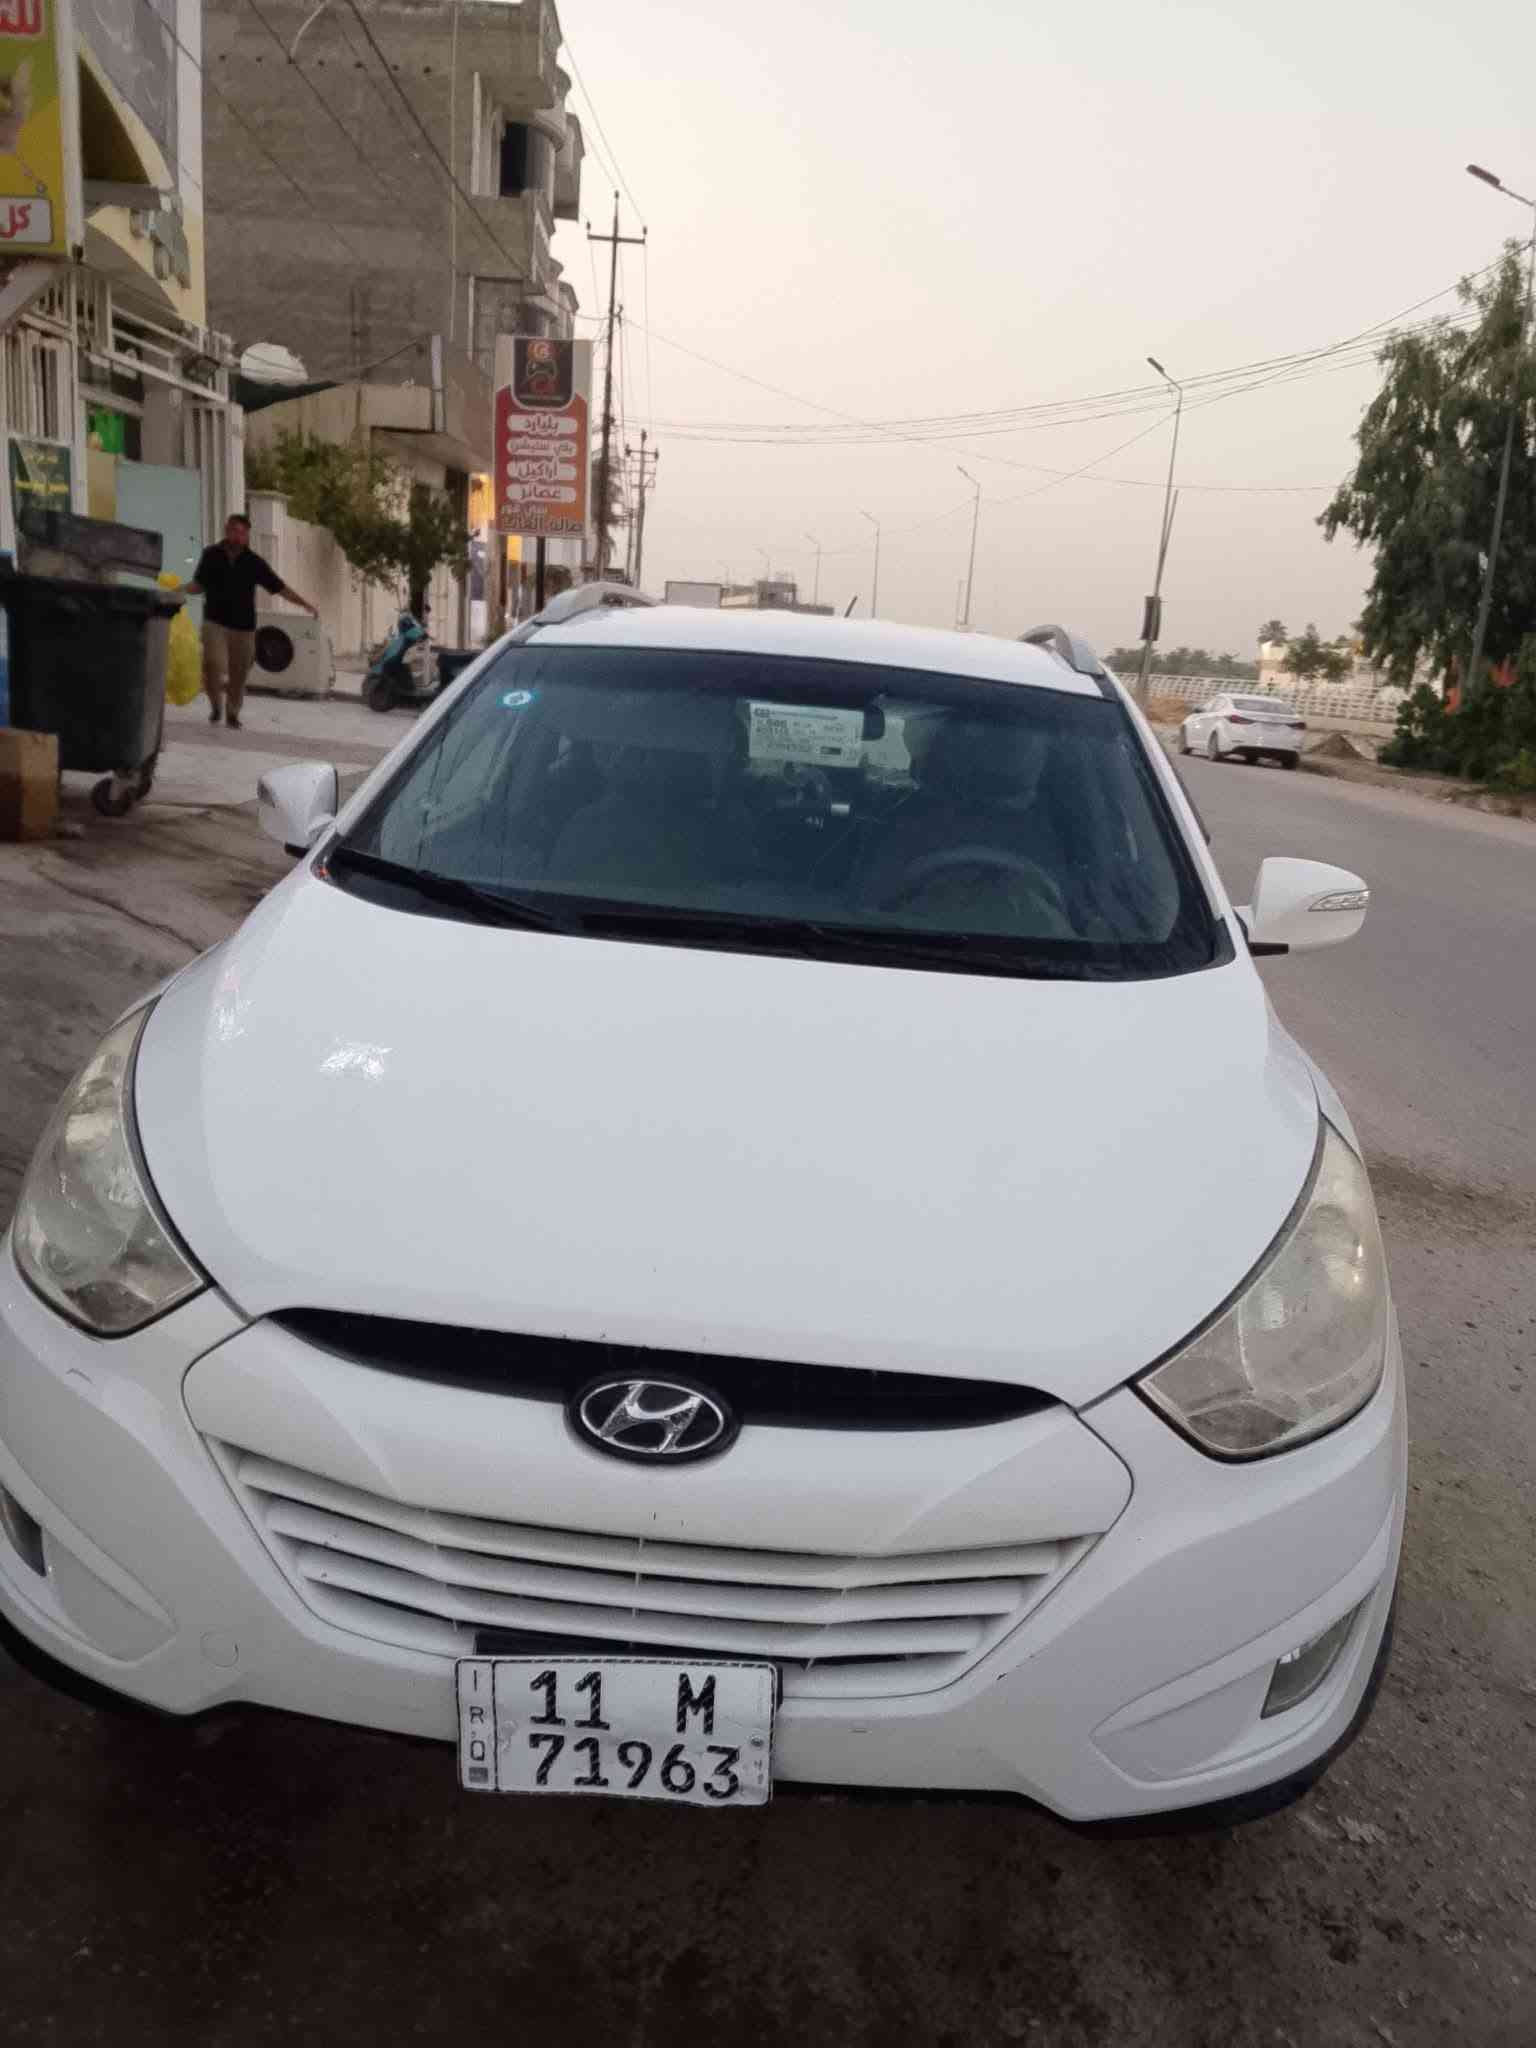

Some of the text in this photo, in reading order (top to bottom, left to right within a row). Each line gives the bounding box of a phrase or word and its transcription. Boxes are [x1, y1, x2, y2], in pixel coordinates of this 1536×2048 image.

[529, 1670, 717, 1736] 11 M
[528, 1733, 741, 1800] 71963
